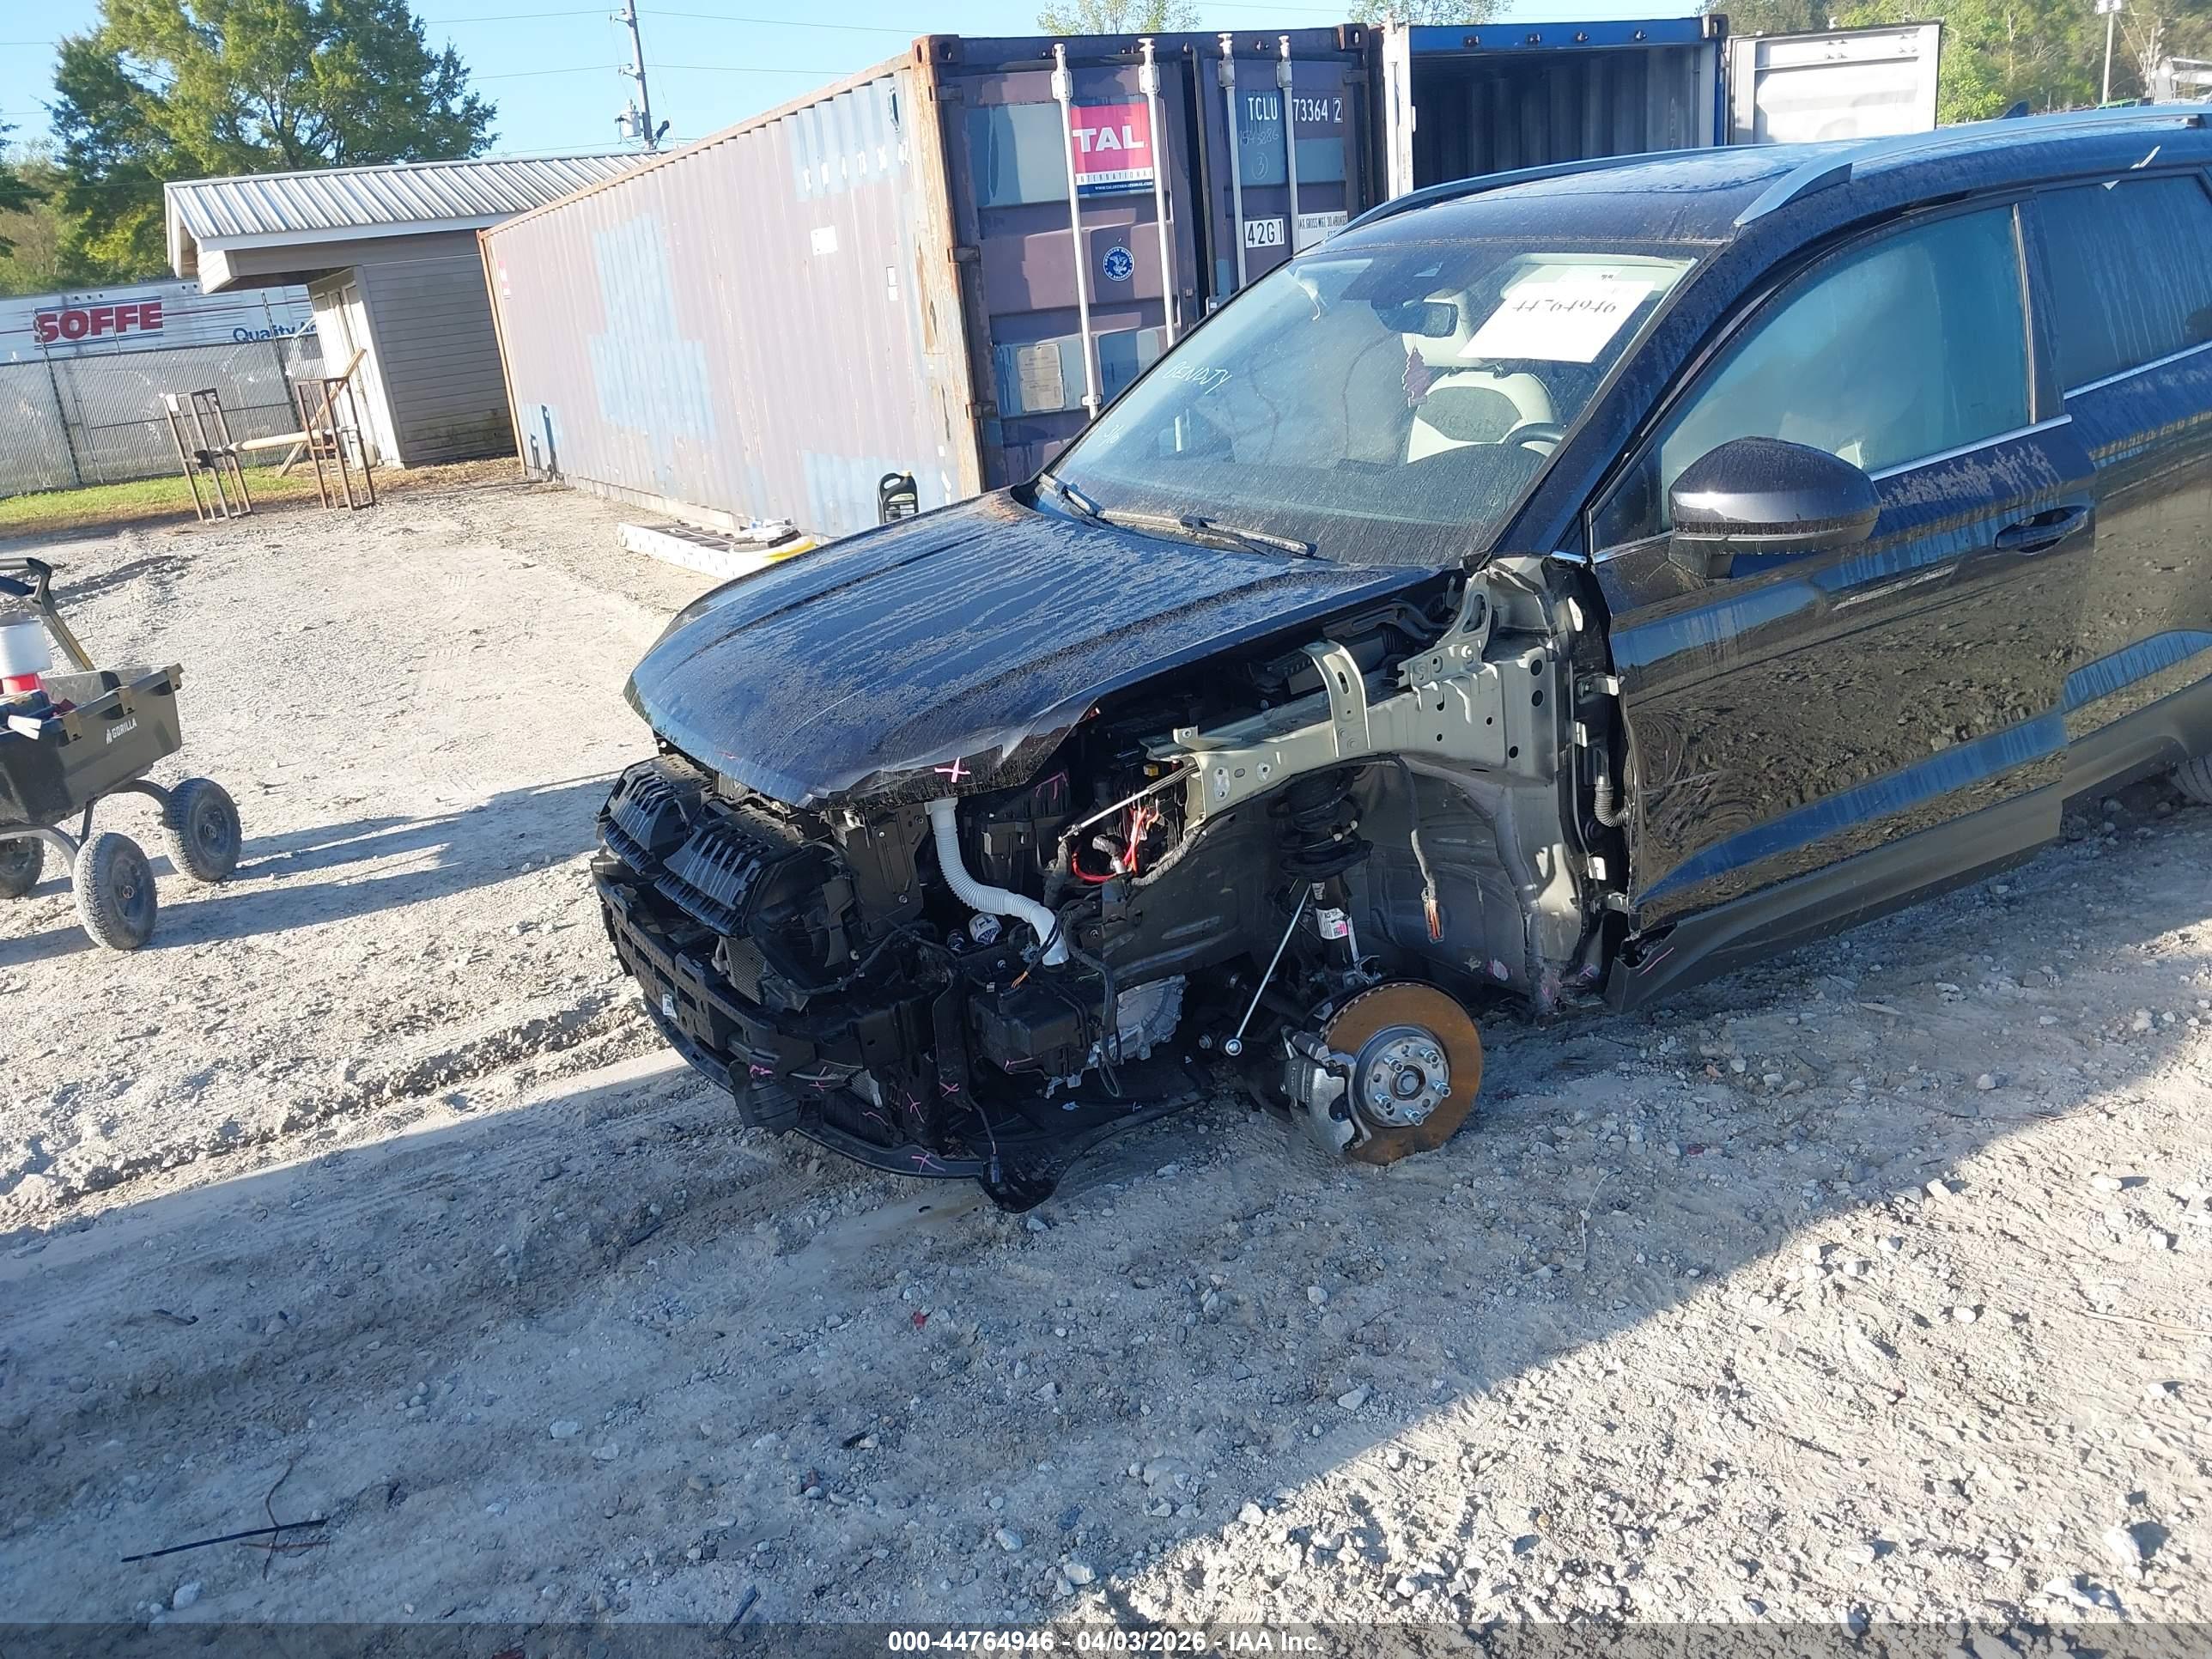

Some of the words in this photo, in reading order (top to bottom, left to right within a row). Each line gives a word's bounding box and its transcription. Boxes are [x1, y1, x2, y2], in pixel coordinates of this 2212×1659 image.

[1248, 97, 1278, 120] TCLU
[1293, 99, 1328, 121] 73364
[1072, 125, 1145, 153] TAL
[1248, 221, 1283, 245] 42G1
[33, 302, 163, 343] SOFFE
[112, 718, 137, 738] GORILLA
